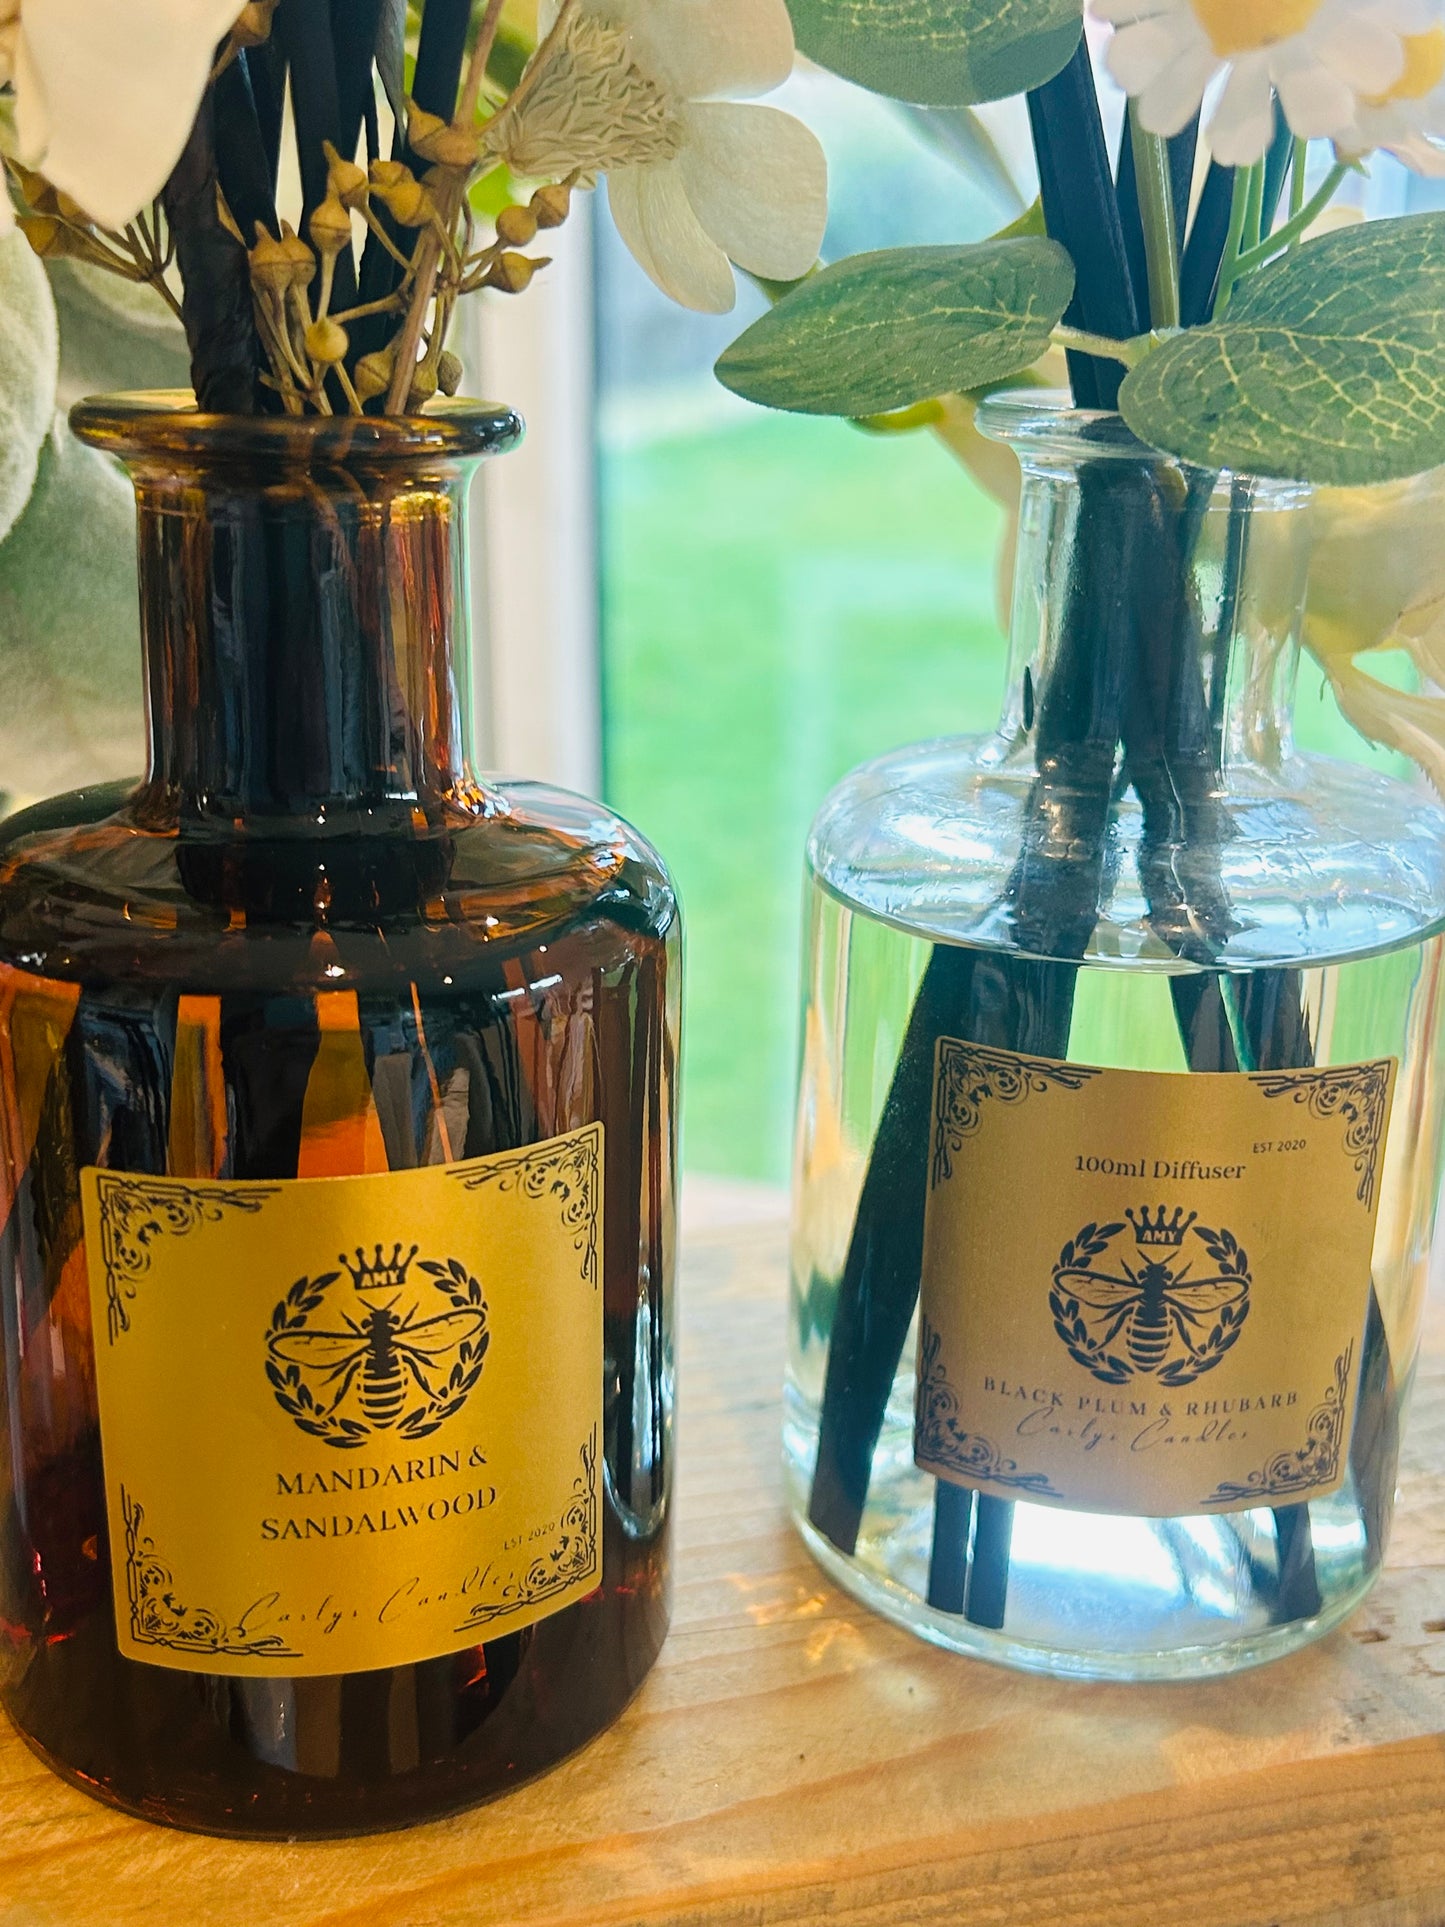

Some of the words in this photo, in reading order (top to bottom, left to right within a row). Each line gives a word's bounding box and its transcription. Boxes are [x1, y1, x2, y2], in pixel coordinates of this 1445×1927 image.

[1253, 1141, 1273, 1154] EST
[1277, 1138, 1307, 1152] 2020
[1075, 1155, 1146, 1178] 100ml
[1153, 1160, 1247, 1180] Diffuser
[1142, 1229, 1178, 1243] AMY
[361, 1269, 401, 1288] AMY
[984, 1376, 1064, 1407] BLACK
[1078, 1395, 1147, 1416] PLUM
[1158, 1403, 1173, 1417] &
[1186, 1391, 1298, 1416] RHUBARB
[275, 1450, 461, 1496] MANDARIN
[468, 1444, 488, 1467] &
[261, 1485, 498, 1541] SANDALWOOD
[503, 1536, 523, 1551] EST
[528, 1522, 556, 1542] 2020
